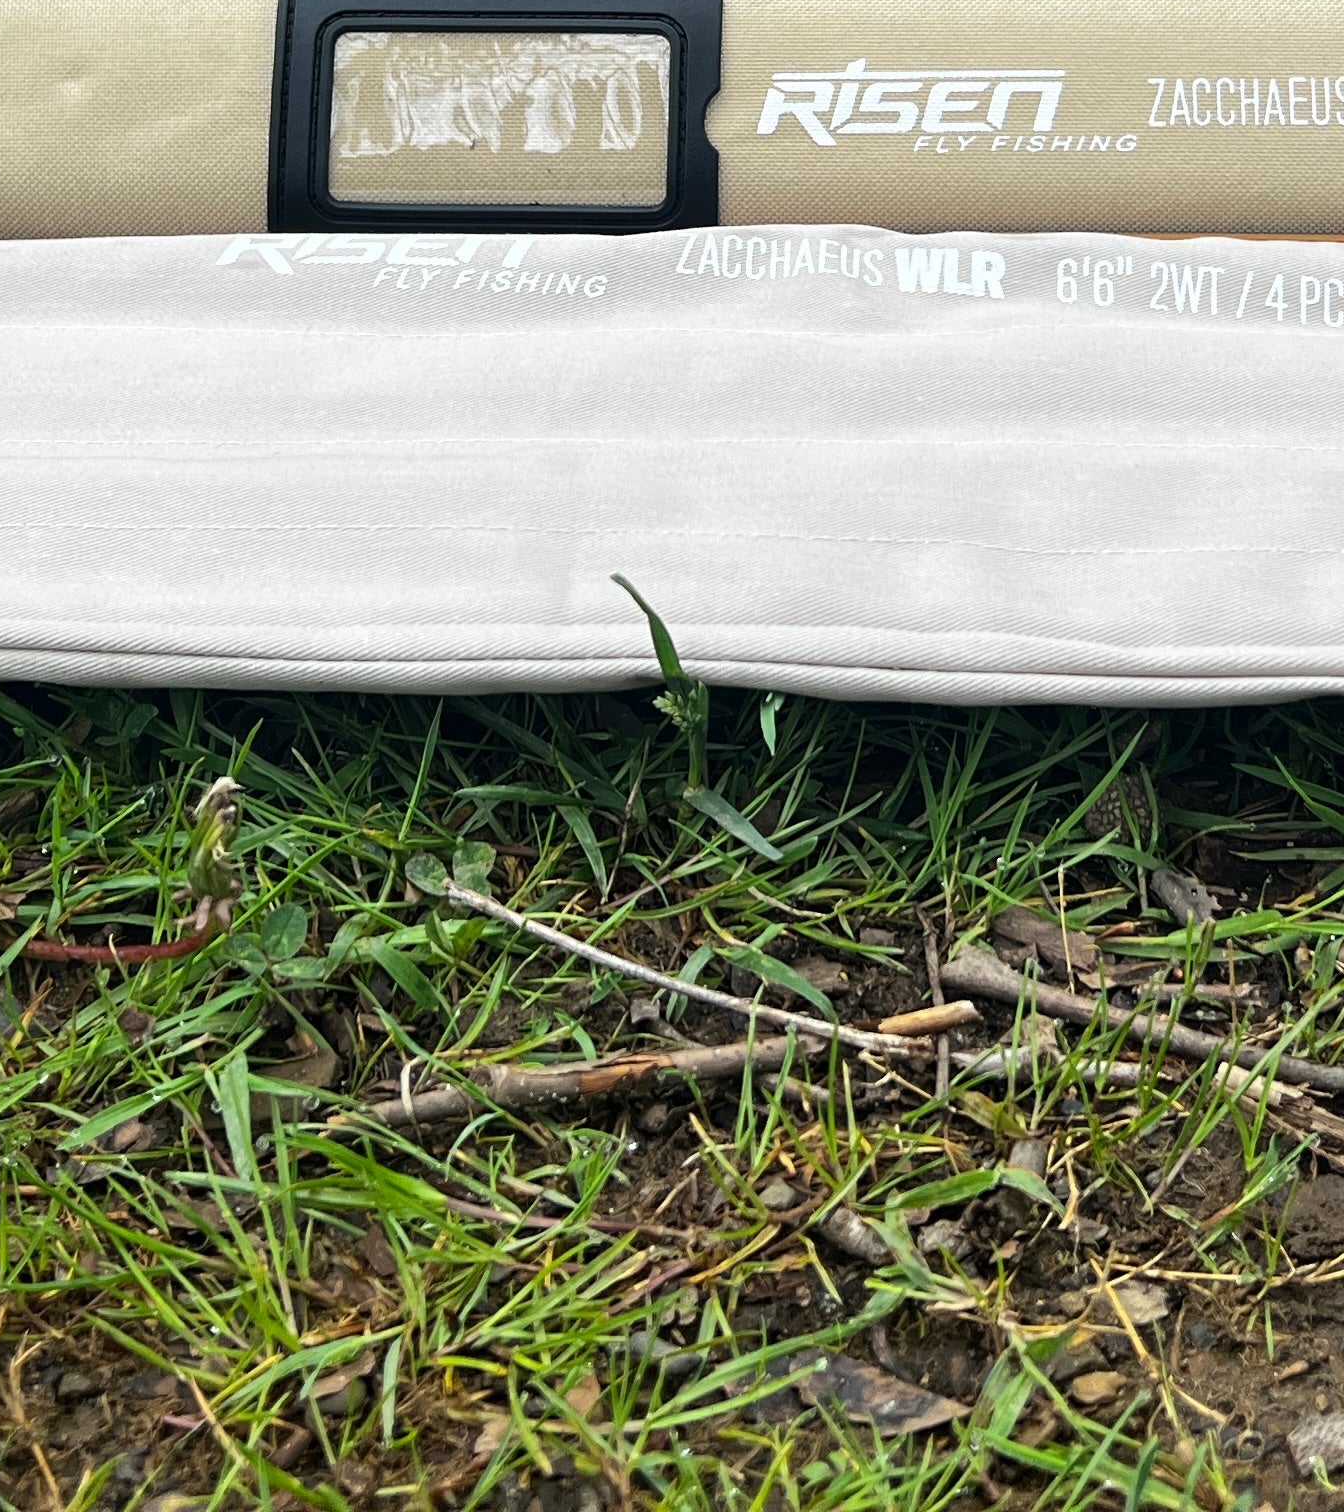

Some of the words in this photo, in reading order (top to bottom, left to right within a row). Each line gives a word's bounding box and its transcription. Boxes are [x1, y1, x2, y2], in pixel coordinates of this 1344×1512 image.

[913, 135, 975, 153] FLY
[990, 134, 1138, 152] FISHING
[372, 268, 445, 289] FLY
[455, 271, 608, 298] FISHING
[675, 234, 884, 287] ZACCHAEUS
[895, 248, 1006, 299] WLR
[1148, 262, 1225, 314] 2WT
